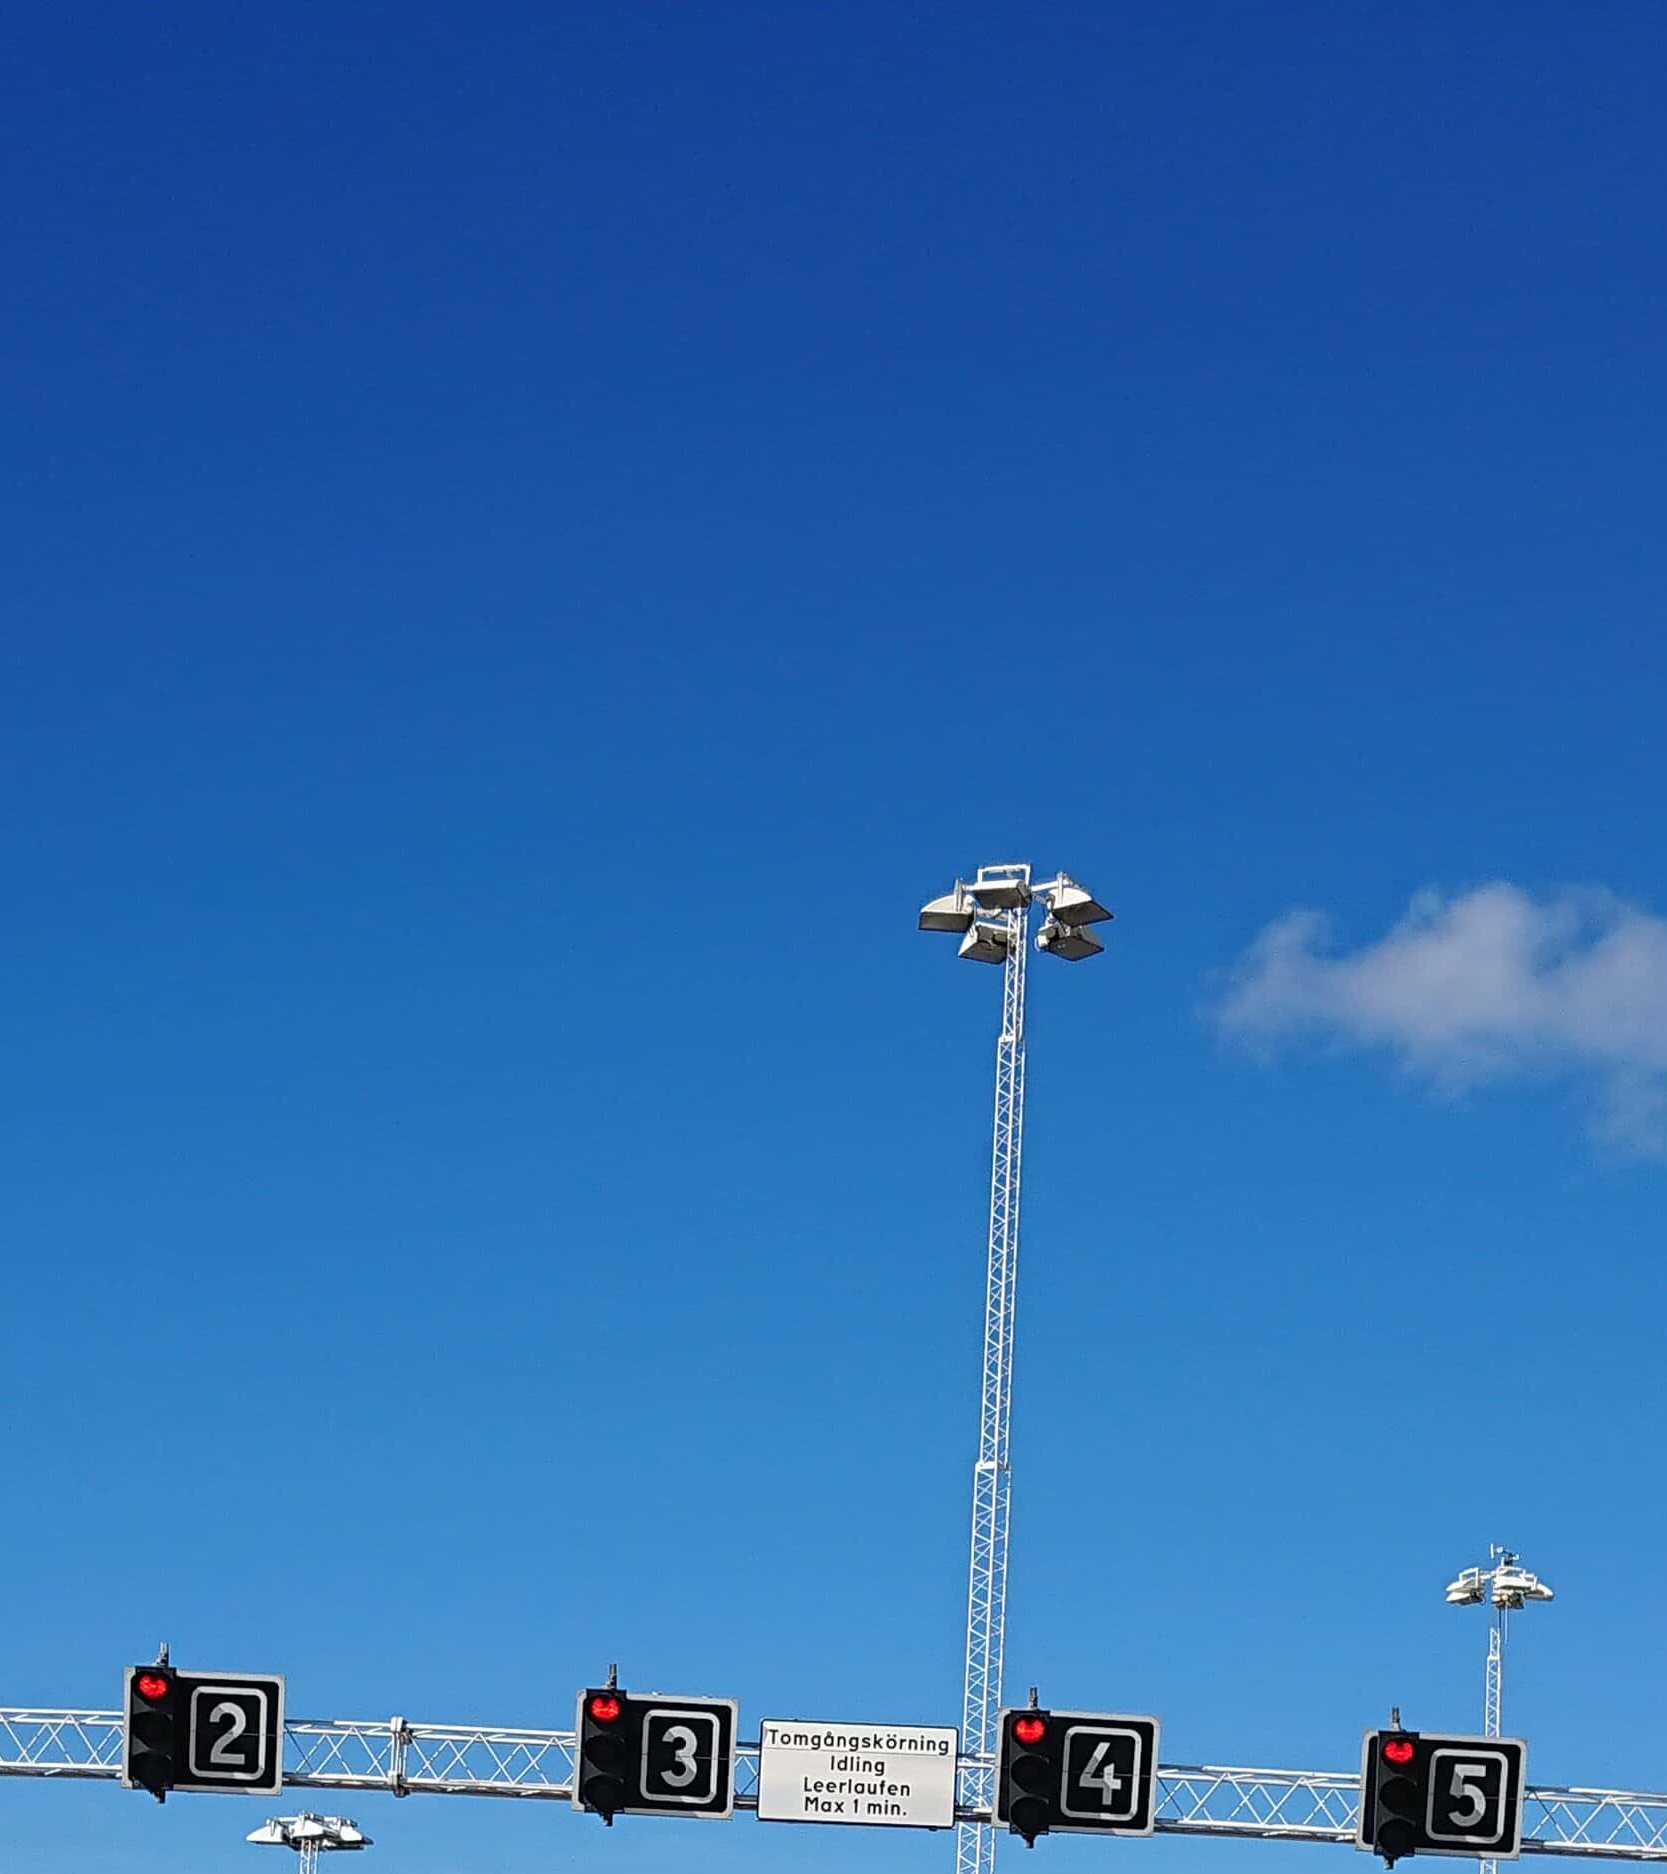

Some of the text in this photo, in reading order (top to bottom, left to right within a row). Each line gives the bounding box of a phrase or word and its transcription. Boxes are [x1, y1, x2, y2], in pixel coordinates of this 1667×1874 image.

[210, 1702, 246, 1764] 2
[768, 1728, 950, 1756] Tomgångskörning
[661, 1726, 697, 1786] 3
[830, 1755, 886, 1777] Idling
[1080, 1742, 1121, 1805] 4
[803, 1776, 911, 1797] Leerlaufen
[804, 1796, 908, 1817] Max 1 min.
[1449, 1764, 1486, 1826] 5
